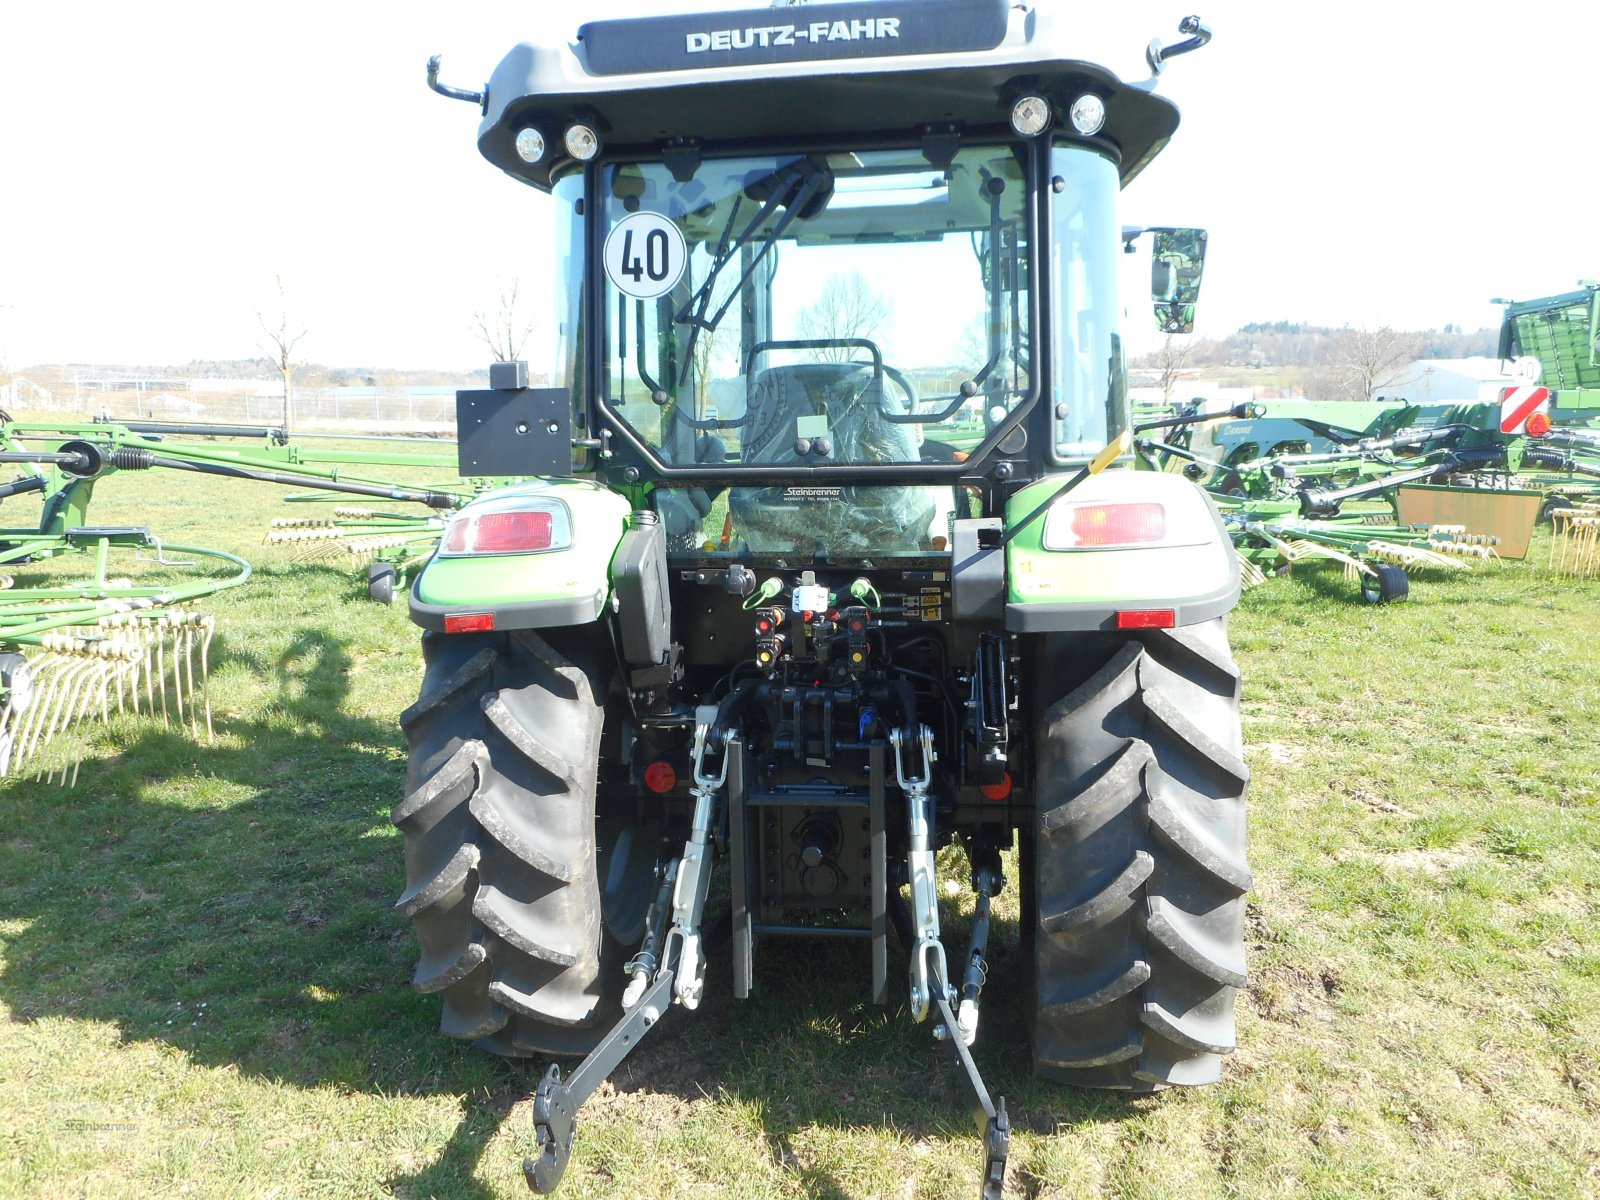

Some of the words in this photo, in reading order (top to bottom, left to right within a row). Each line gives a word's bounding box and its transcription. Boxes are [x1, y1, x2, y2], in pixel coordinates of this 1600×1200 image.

[686, 17, 901, 53] DEUTZ-FAHR
[621, 228, 669, 282] 40
[783, 486, 841, 496] Steinbrenner
